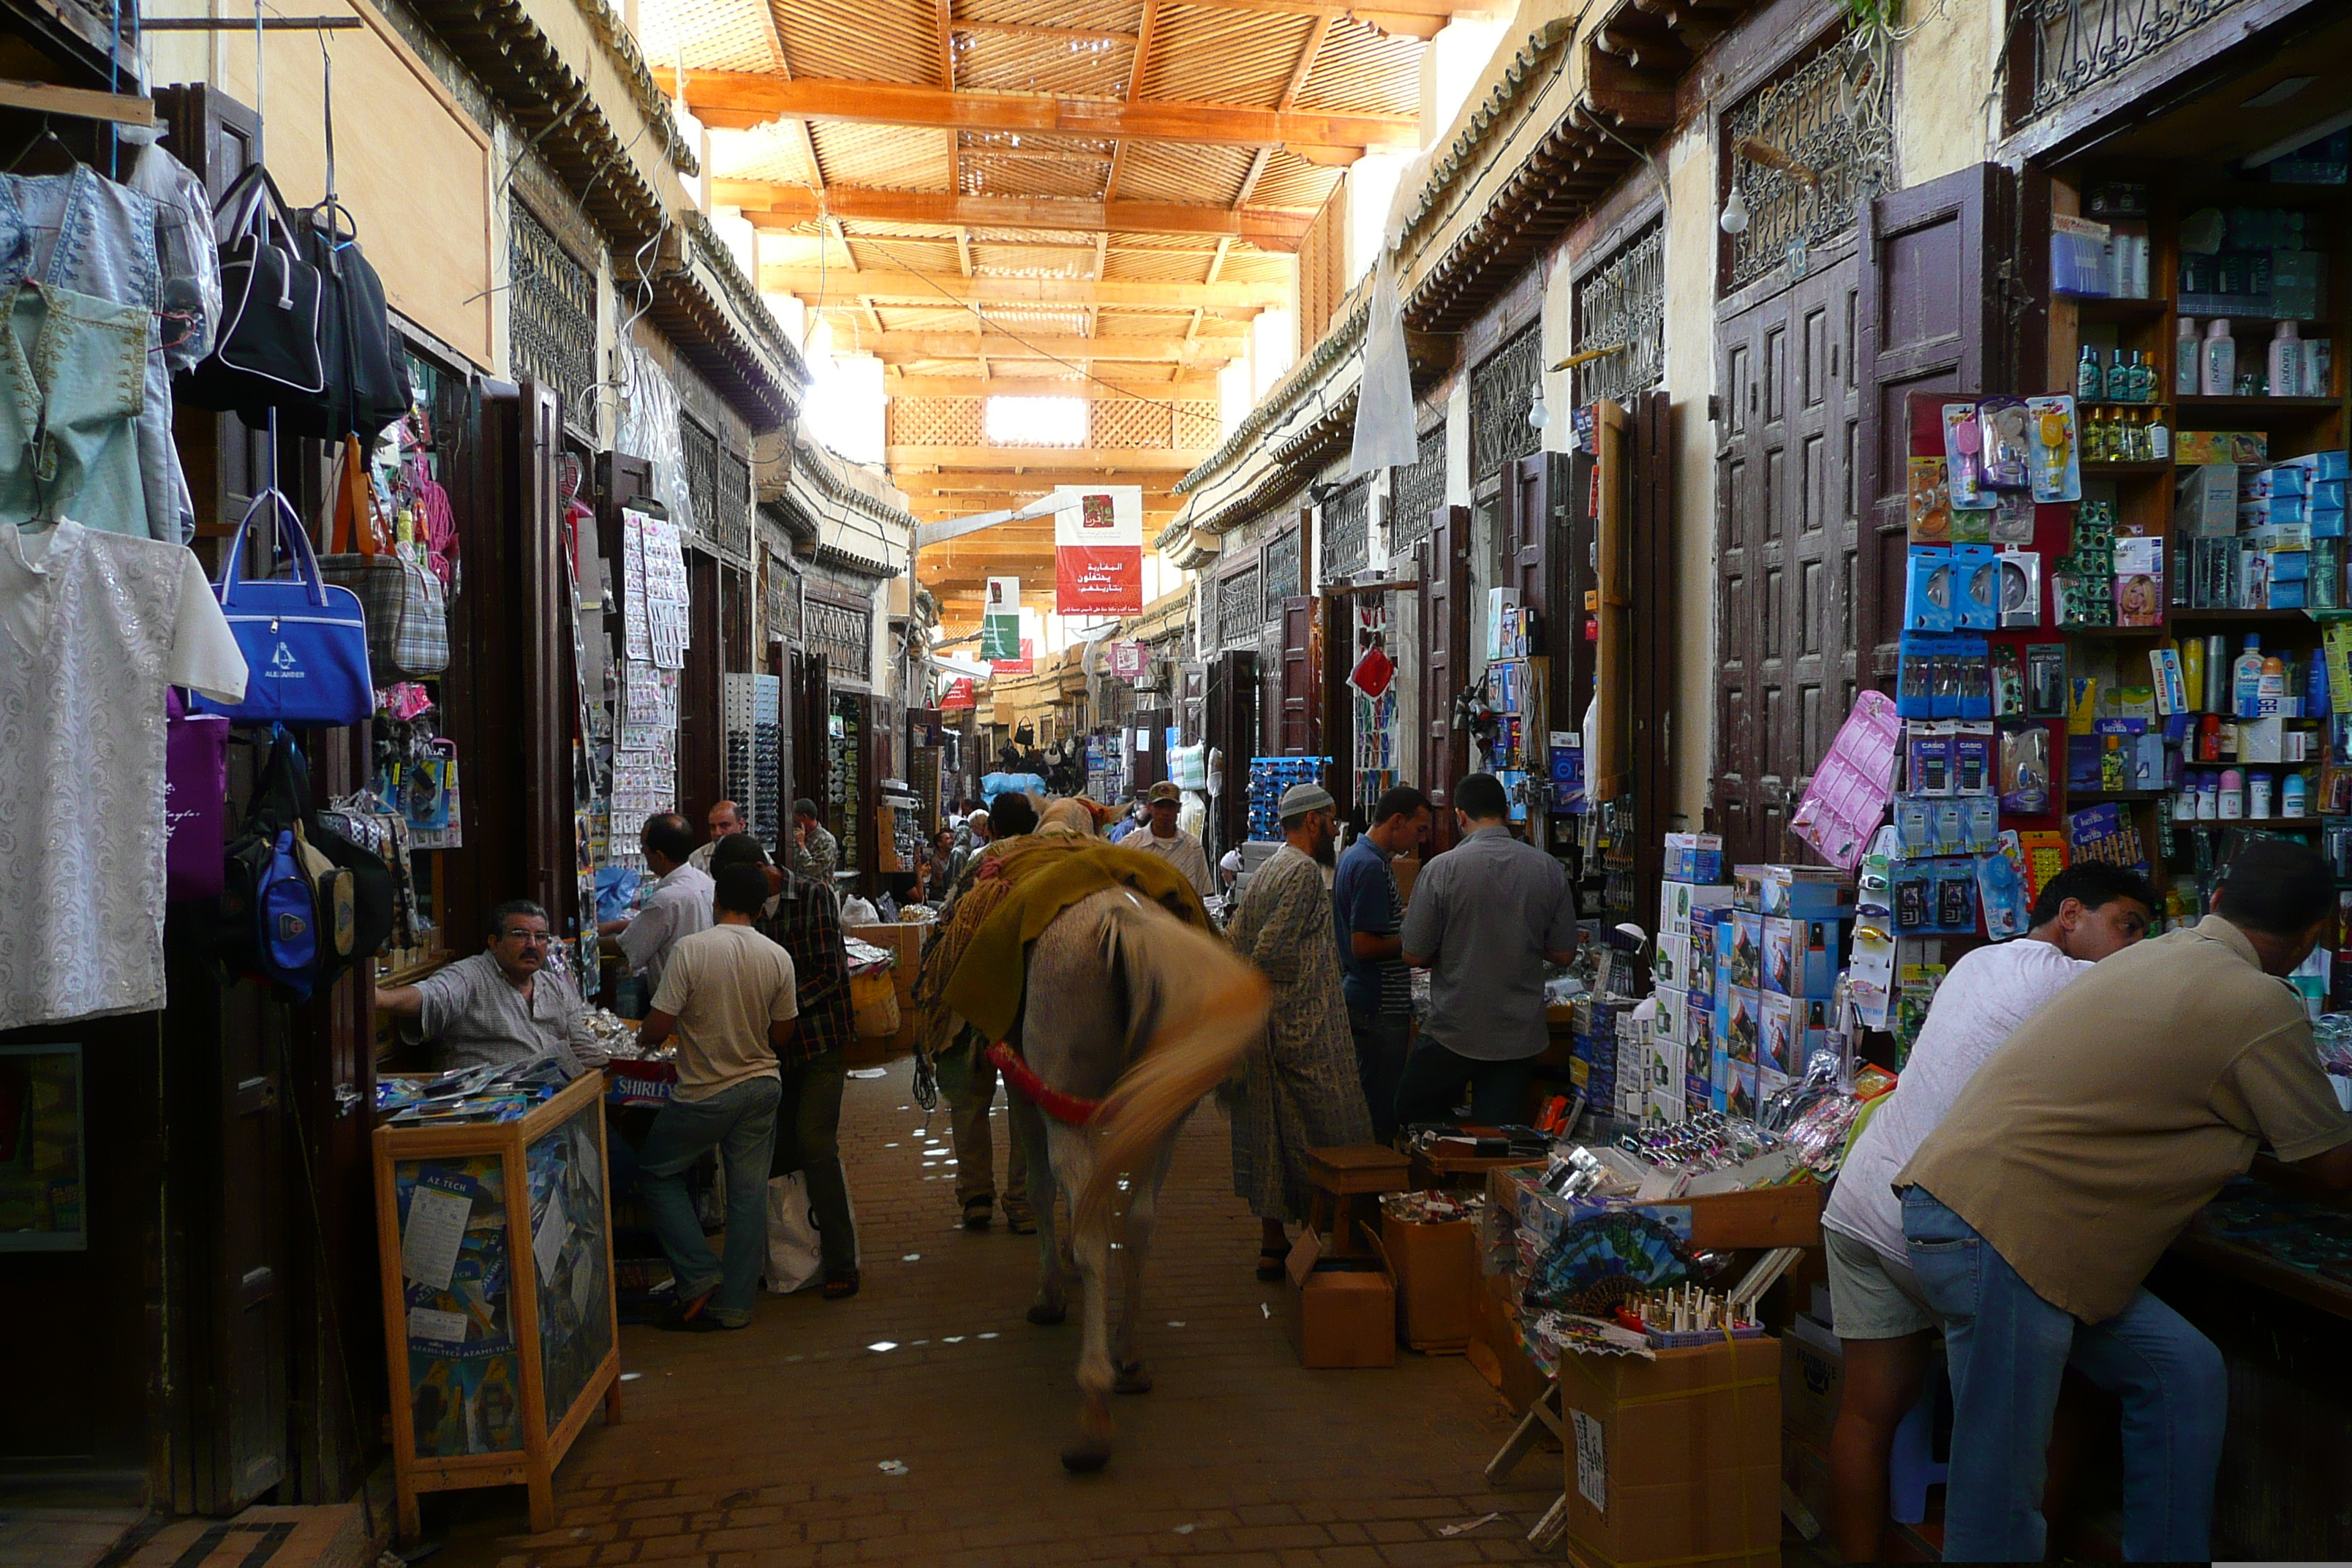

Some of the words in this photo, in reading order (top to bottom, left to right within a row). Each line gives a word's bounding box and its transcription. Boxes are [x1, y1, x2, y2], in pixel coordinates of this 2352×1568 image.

[1088, 562, 1123, 572] المغاربة
[1077, 573, 1111, 583] يحتفلون
[2157, 668, 2167, 697] Hashmi
[2258, 699, 2277, 716] GEL
[618, 1079, 674, 1098] SHIRLEY
